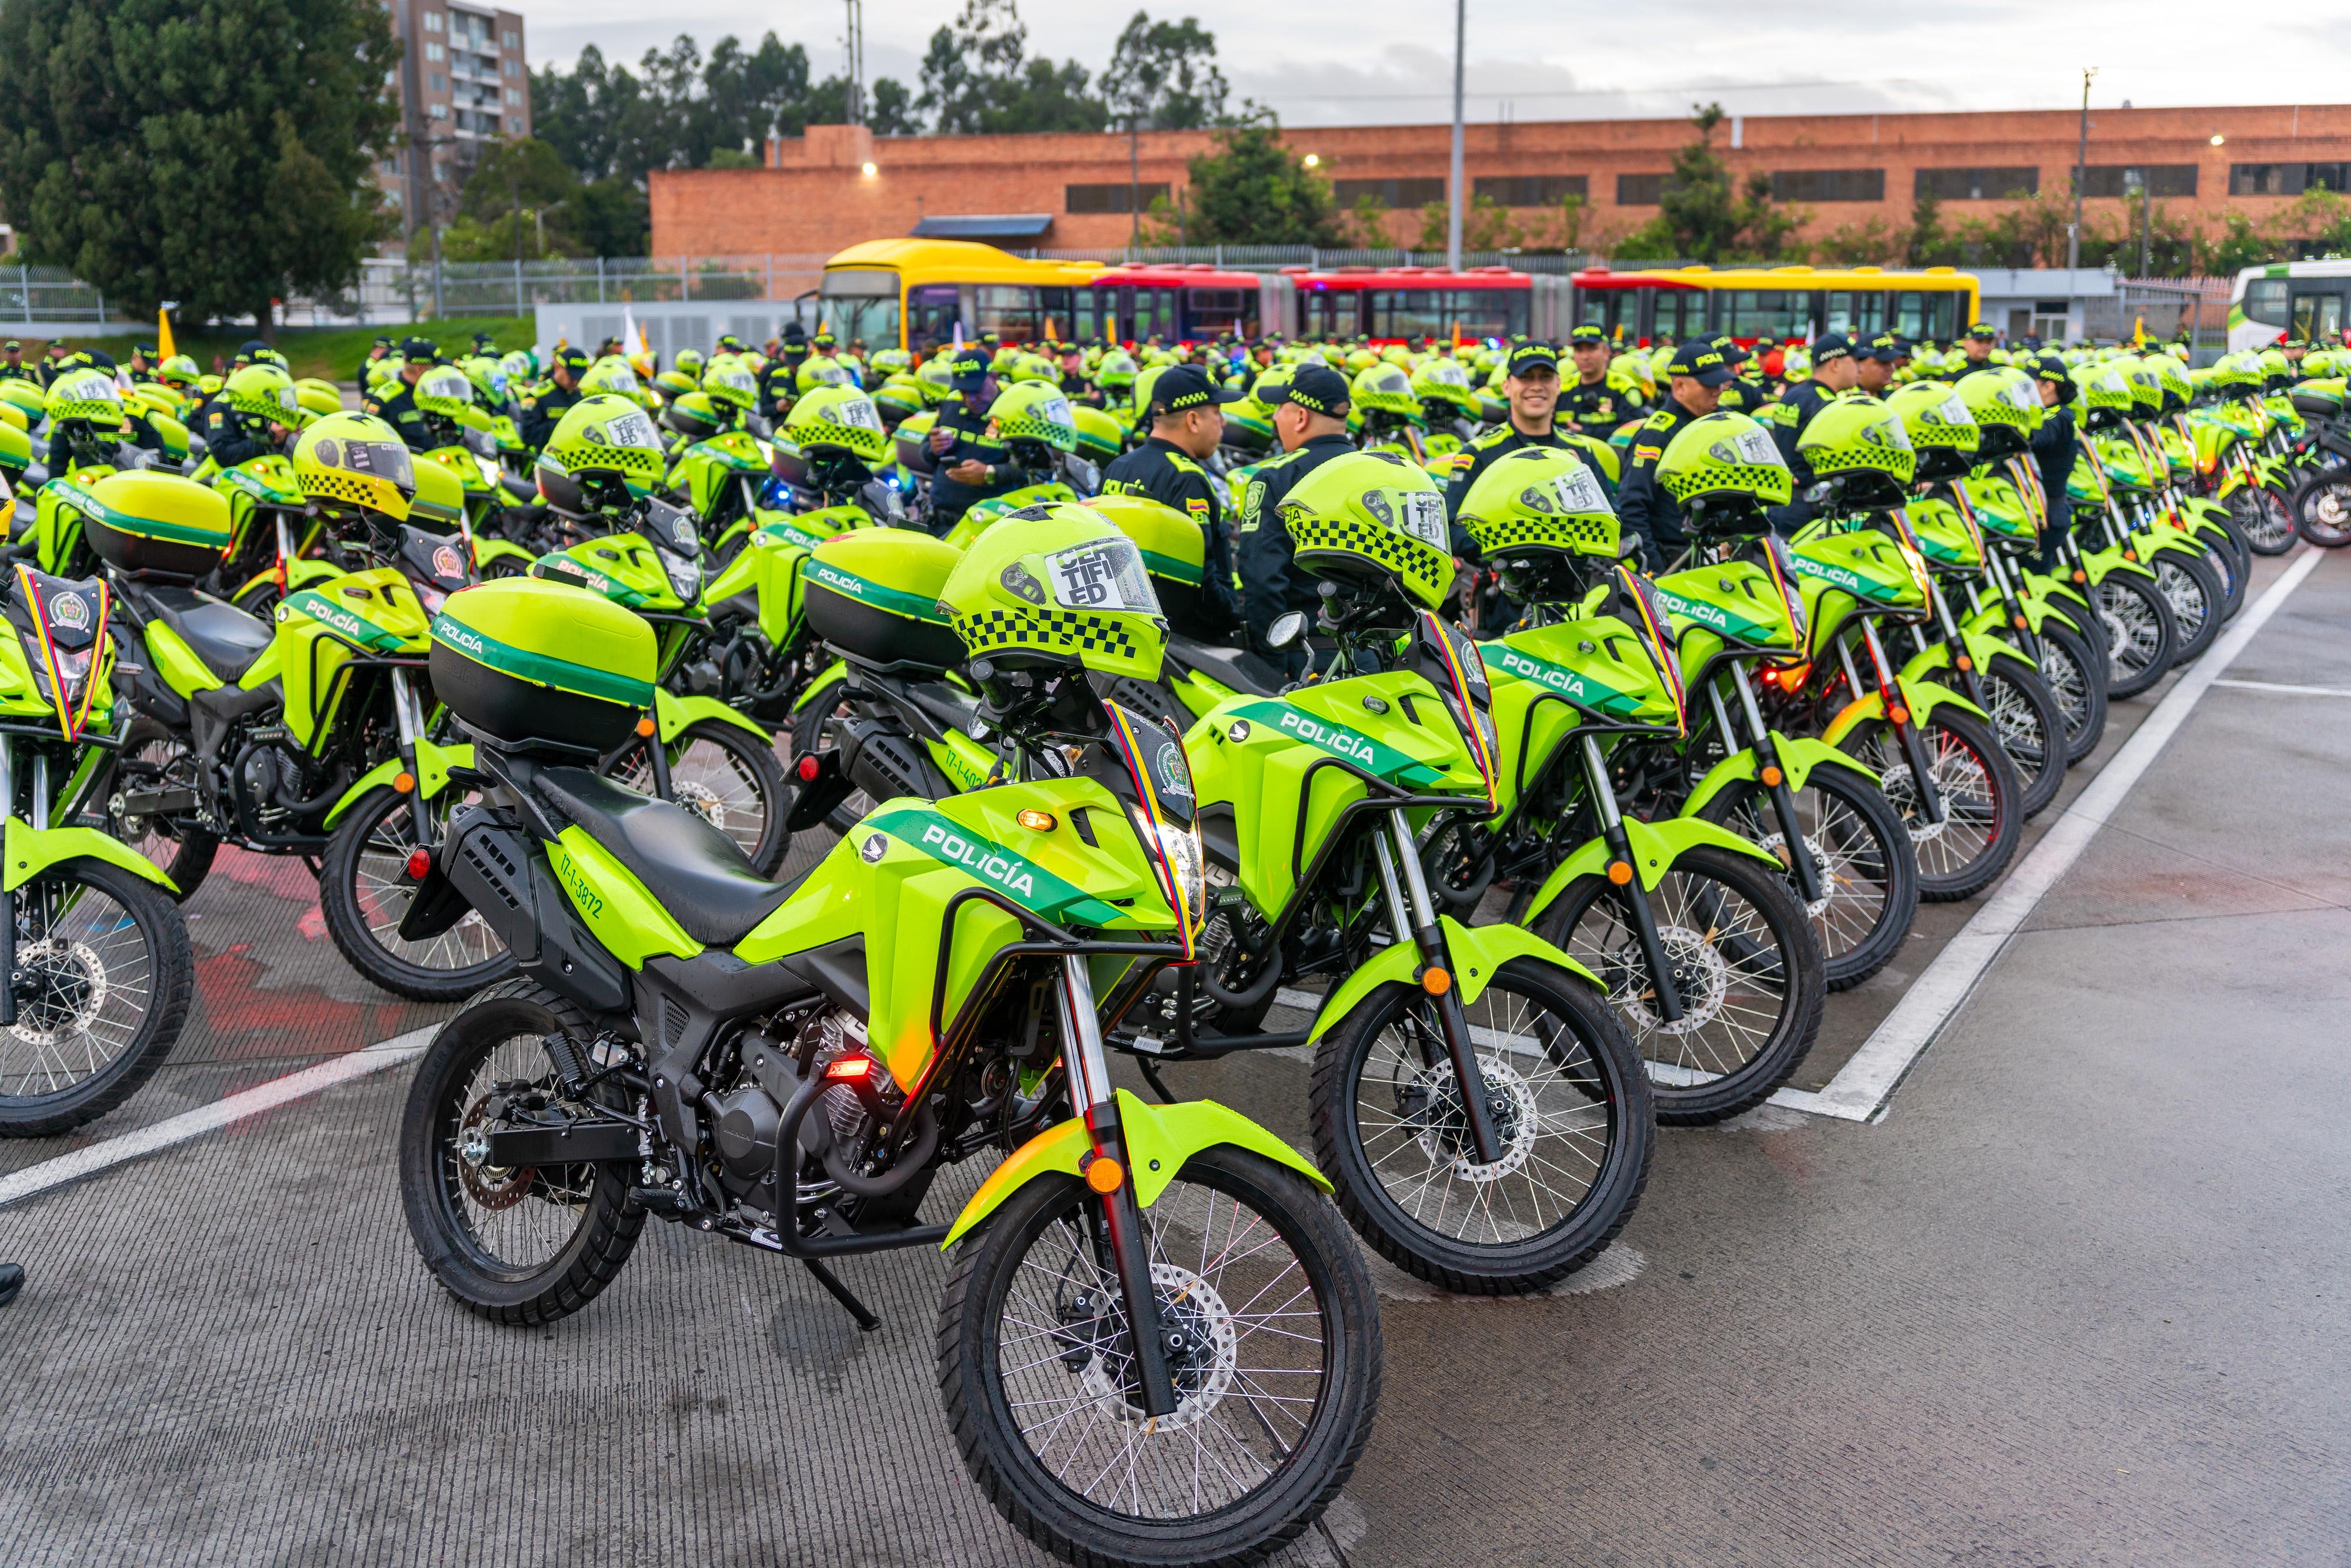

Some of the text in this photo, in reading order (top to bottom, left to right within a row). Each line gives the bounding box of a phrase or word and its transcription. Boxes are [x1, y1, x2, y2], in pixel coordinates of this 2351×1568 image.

[1418, 522, 1439, 539] ED
[818, 568, 862, 594] POLICÍA
[1060, 559, 1113, 589] TIFI
[1795, 557, 1858, 589] POLICÍA
[1068, 582, 1107, 605] ED
[305, 599, 360, 636] POLICÍA
[440, 622, 483, 654] POLICÍA
[1502, 653, 1583, 698] POLICÍA
[1280, 711, 1374, 765] POLICÍA
[862, 849, 878, 860] HONDA
[922, 824, 1033, 898] POLICÍA
[561, 853, 602, 919] 17-1-3872
[724, 1127, 752, 1141] HONDA
